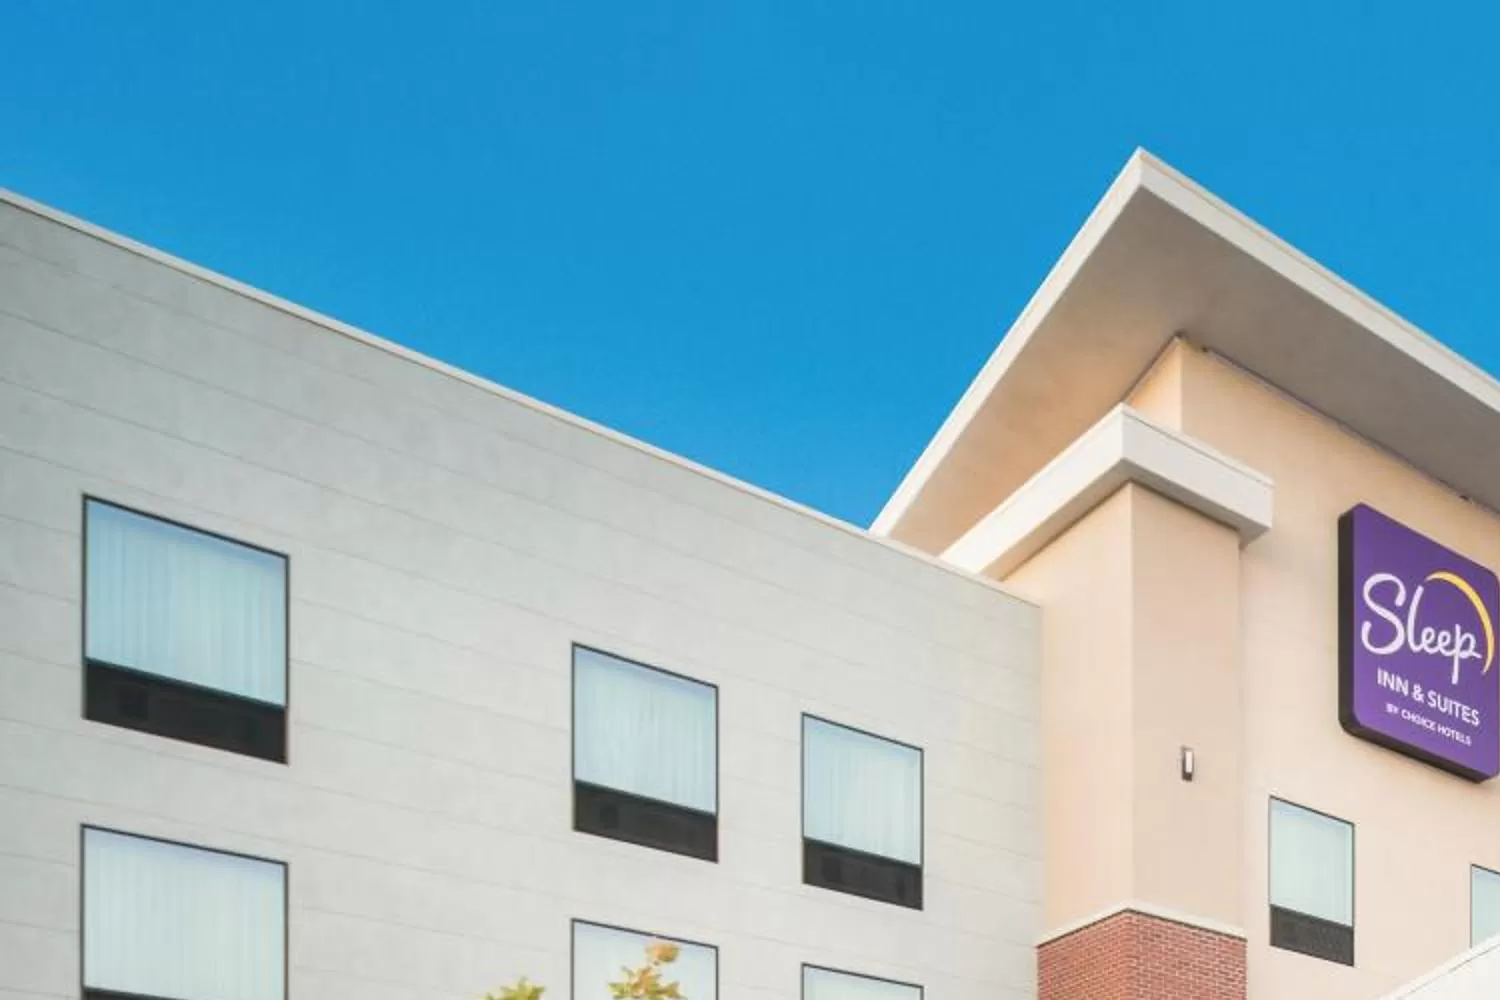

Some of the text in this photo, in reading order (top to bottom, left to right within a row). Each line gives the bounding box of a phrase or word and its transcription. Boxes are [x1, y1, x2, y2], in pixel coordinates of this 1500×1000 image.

[1361, 573, 1482, 684] Sleep
[1377, 667, 1480, 727] INN & SUITES
[1385, 702, 1472, 747] BY CHOICE HOTELS
